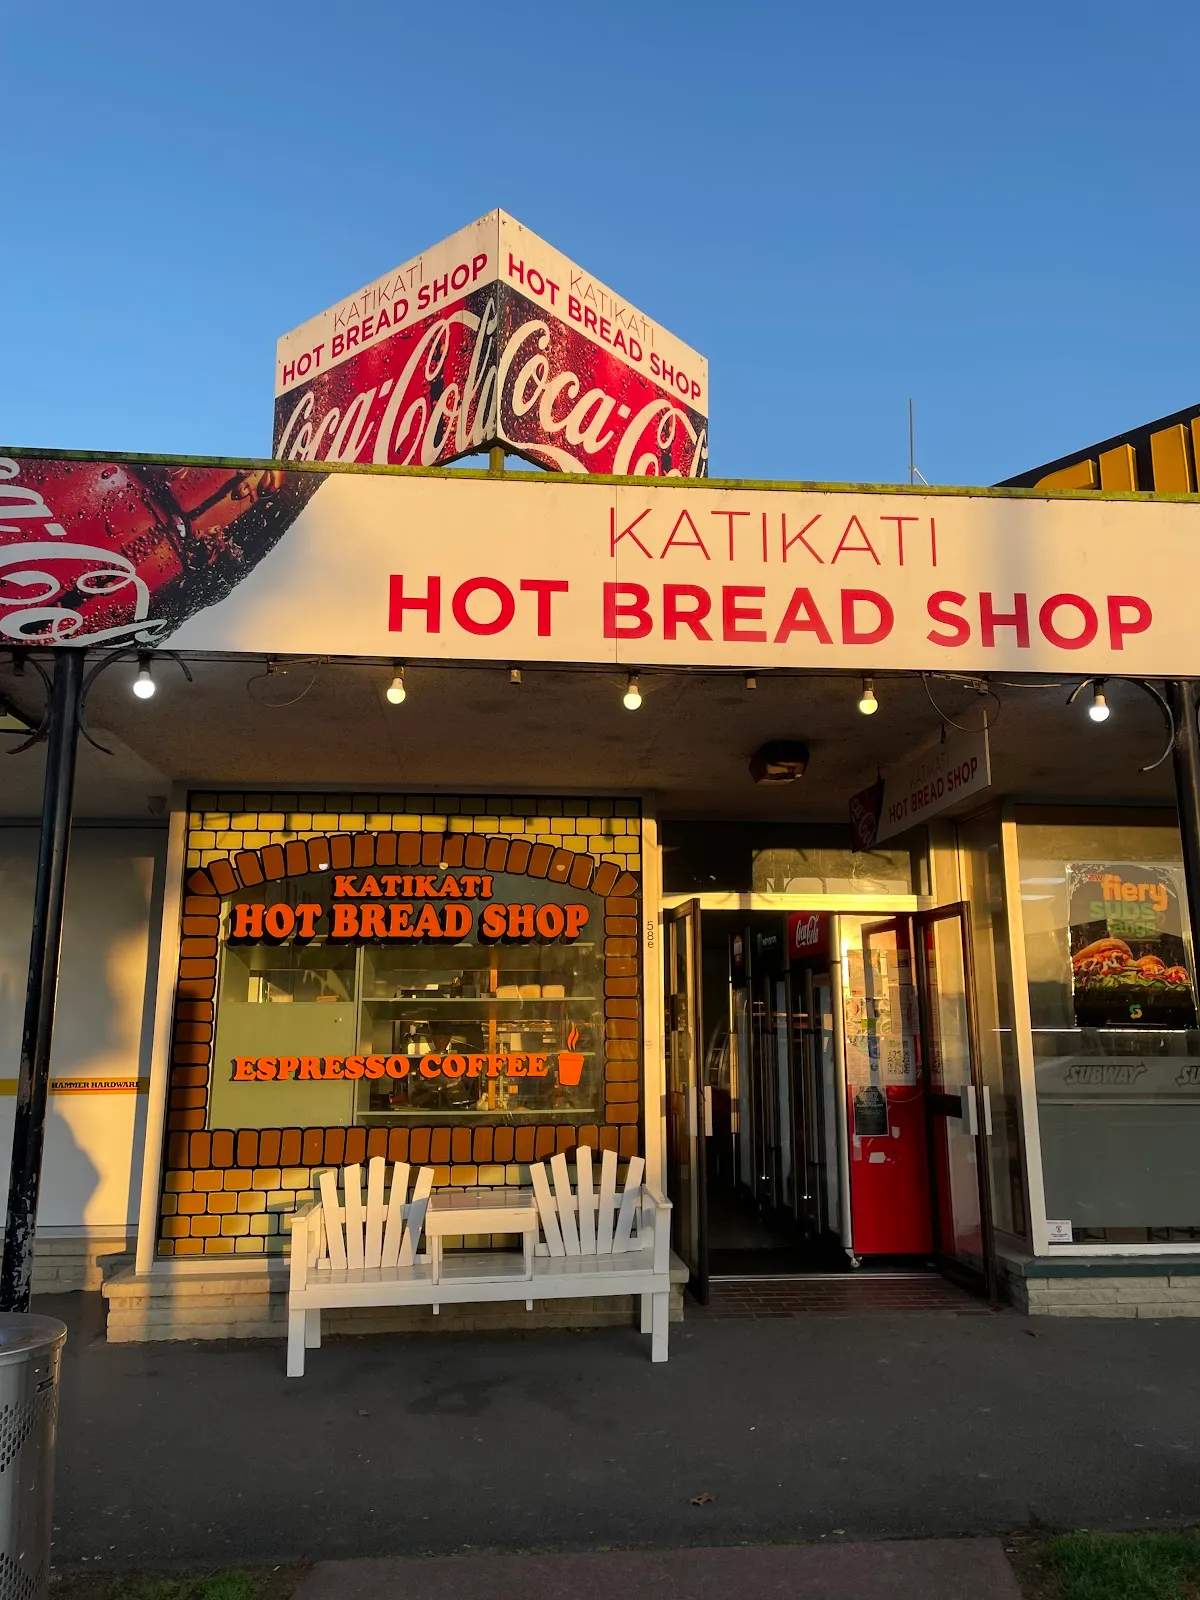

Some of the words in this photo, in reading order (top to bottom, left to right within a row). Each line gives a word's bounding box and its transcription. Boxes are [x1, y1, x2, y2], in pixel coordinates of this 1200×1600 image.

[282, 344, 325, 386] HOT
[331, 298, 409, 359] BREAD
[417, 253, 488, 310] SHOP
[334, 262, 423, 331] KATIKATI
[508, 252, 560, 305] HOT
[568, 294, 643, 362] BREAD
[650, 352, 701, 401] SHOP
[570, 269, 654, 347] KATIKATI
[609, 507, 938, 567] KATIKATI
[388, 573, 569, 637] HOT
[602, 581, 895, 645] BREAD
[926, 590, 1154, 651] SHOP
[889, 798, 908, 825] HOT
[911, 778, 944, 812] BREAD
[947, 757, 978, 791] SHOP
[333, 874, 494, 899] KATIKATI
[1100, 873, 1168, 912] fiery
[231, 903, 322, 940] HOT
[331, 903, 474, 940] BREAD
[481, 903, 590, 940] SHOP
[52, 1081, 90, 1089] HAMMER
[91, 1080, 141, 1088] HARDWARE
[232, 1055, 411, 1082] ESPRESSO
[418, 1054, 549, 1079] COFFEE
[1065, 1062, 1147, 1087] SUBWAY
